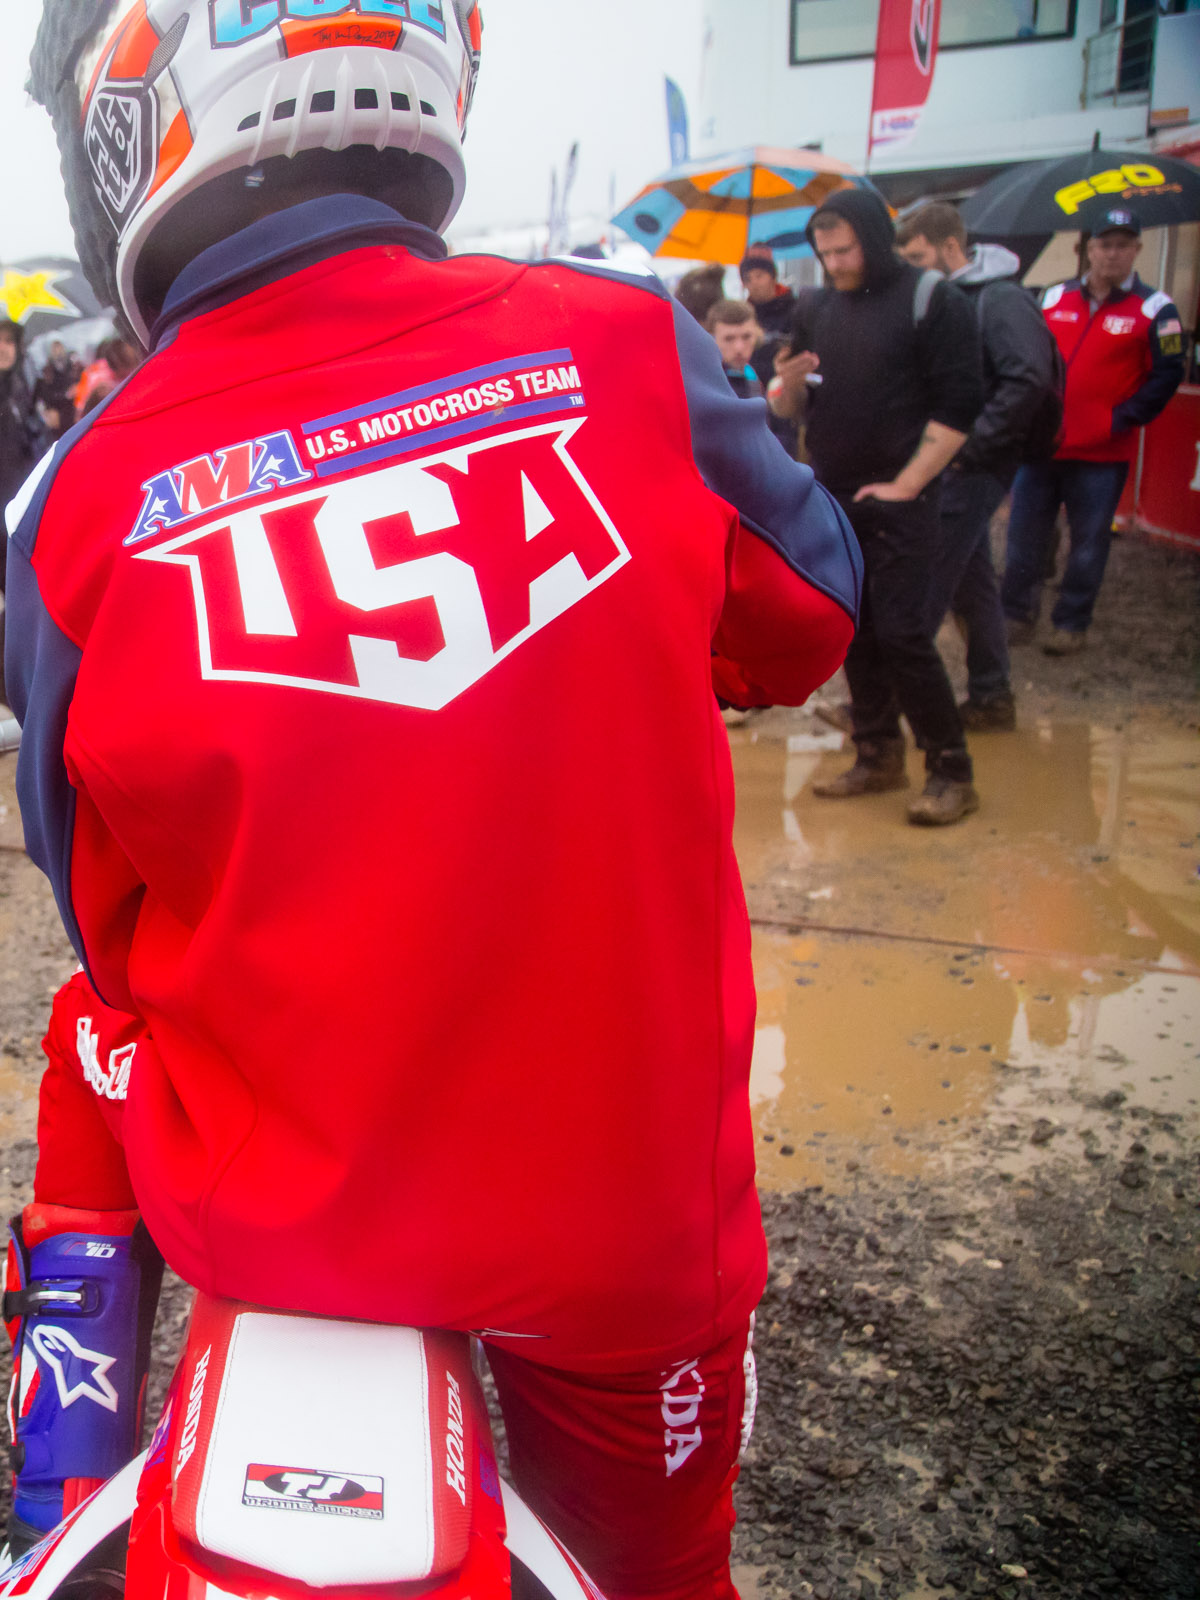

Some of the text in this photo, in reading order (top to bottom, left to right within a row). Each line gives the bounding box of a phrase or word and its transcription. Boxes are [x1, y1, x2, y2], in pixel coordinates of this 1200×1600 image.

[305, 365, 585, 460] U.S. MOTOCROSS TEAM TM
[123, 429, 313, 547] AMA
[145, 422, 628, 702] USA
[175, 1344, 211, 1481] HONDA
[446, 1370, 467, 1507] HONDA
[280, 1471, 348, 1500] TJ
